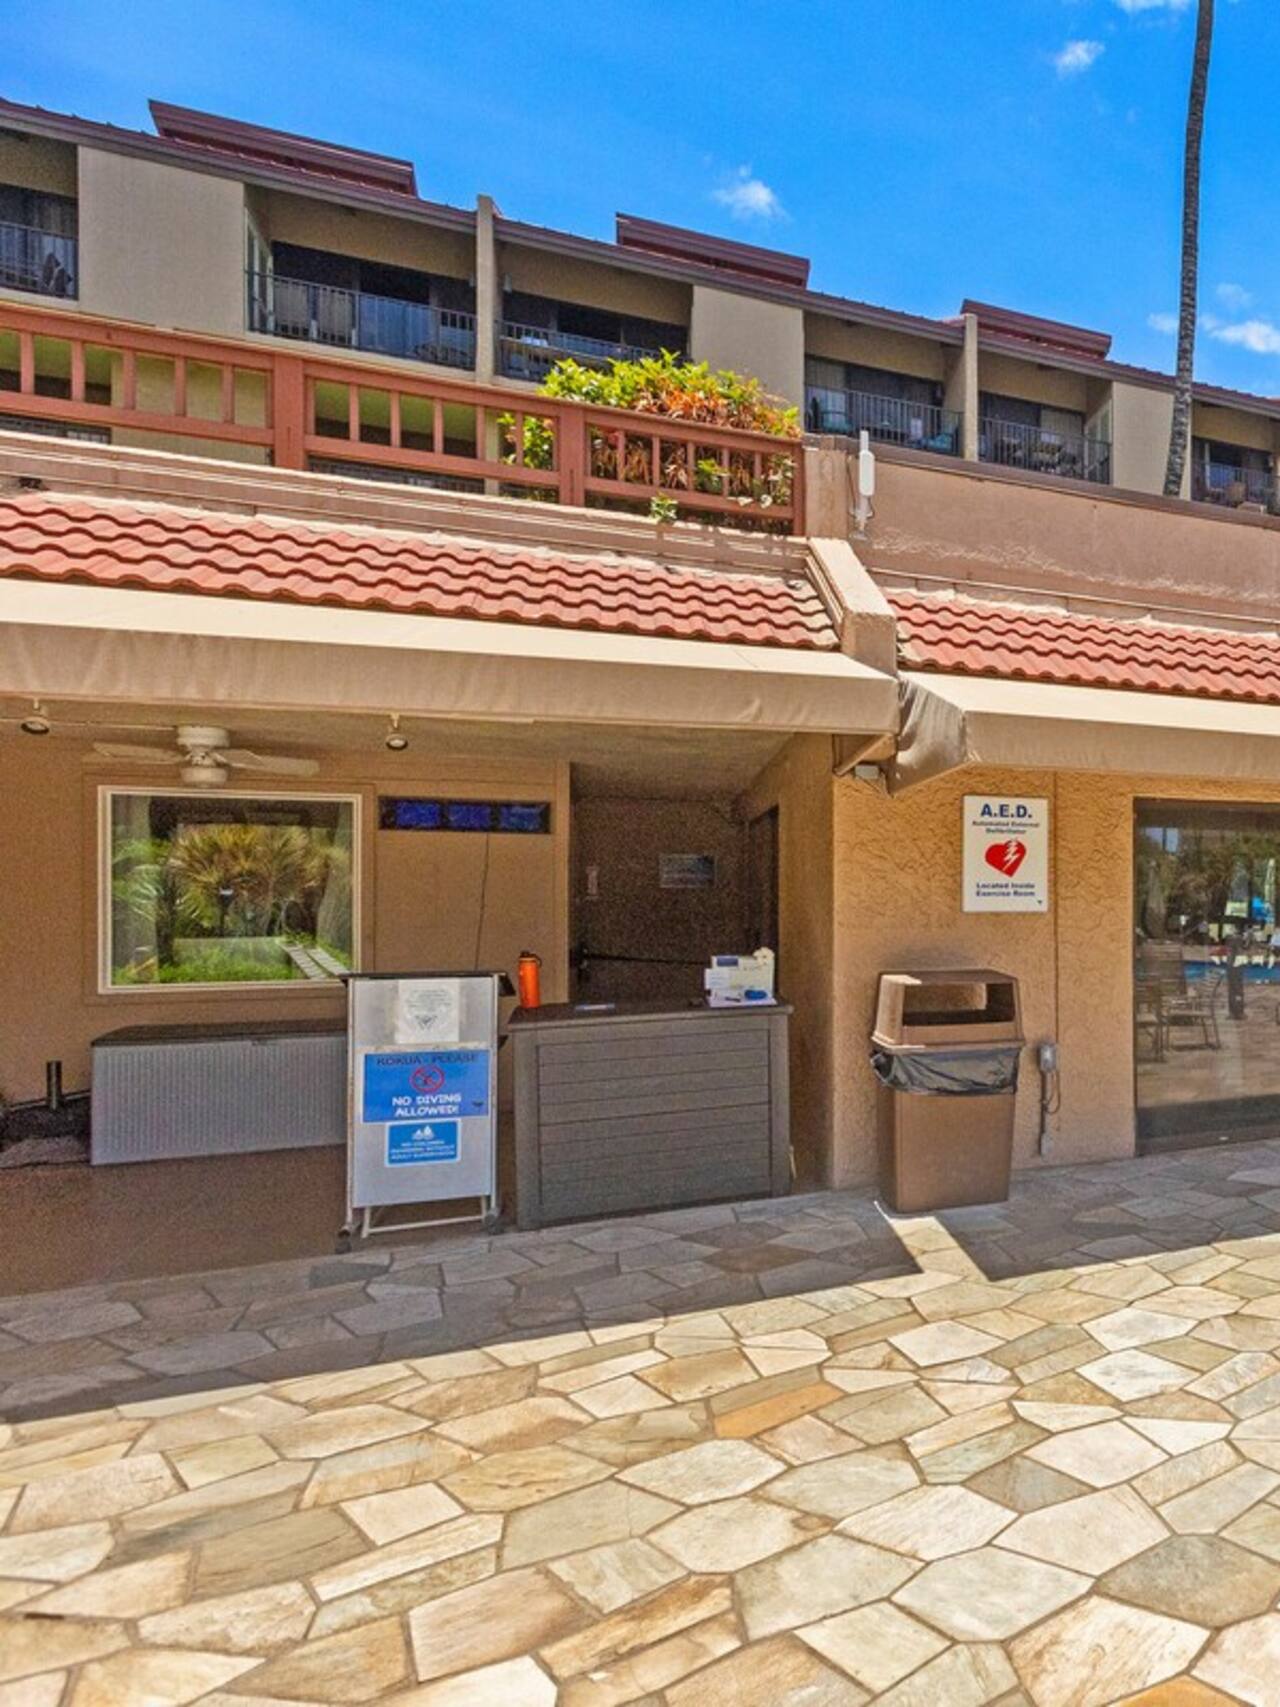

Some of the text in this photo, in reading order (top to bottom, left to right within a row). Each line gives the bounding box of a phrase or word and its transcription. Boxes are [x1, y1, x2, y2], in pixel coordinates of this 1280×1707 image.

[981, 803, 1033, 819] A.E.D.
[392, 1093, 462, 1107] NO DIVING
[394, 1105, 460, 1117] ALLOWED!
